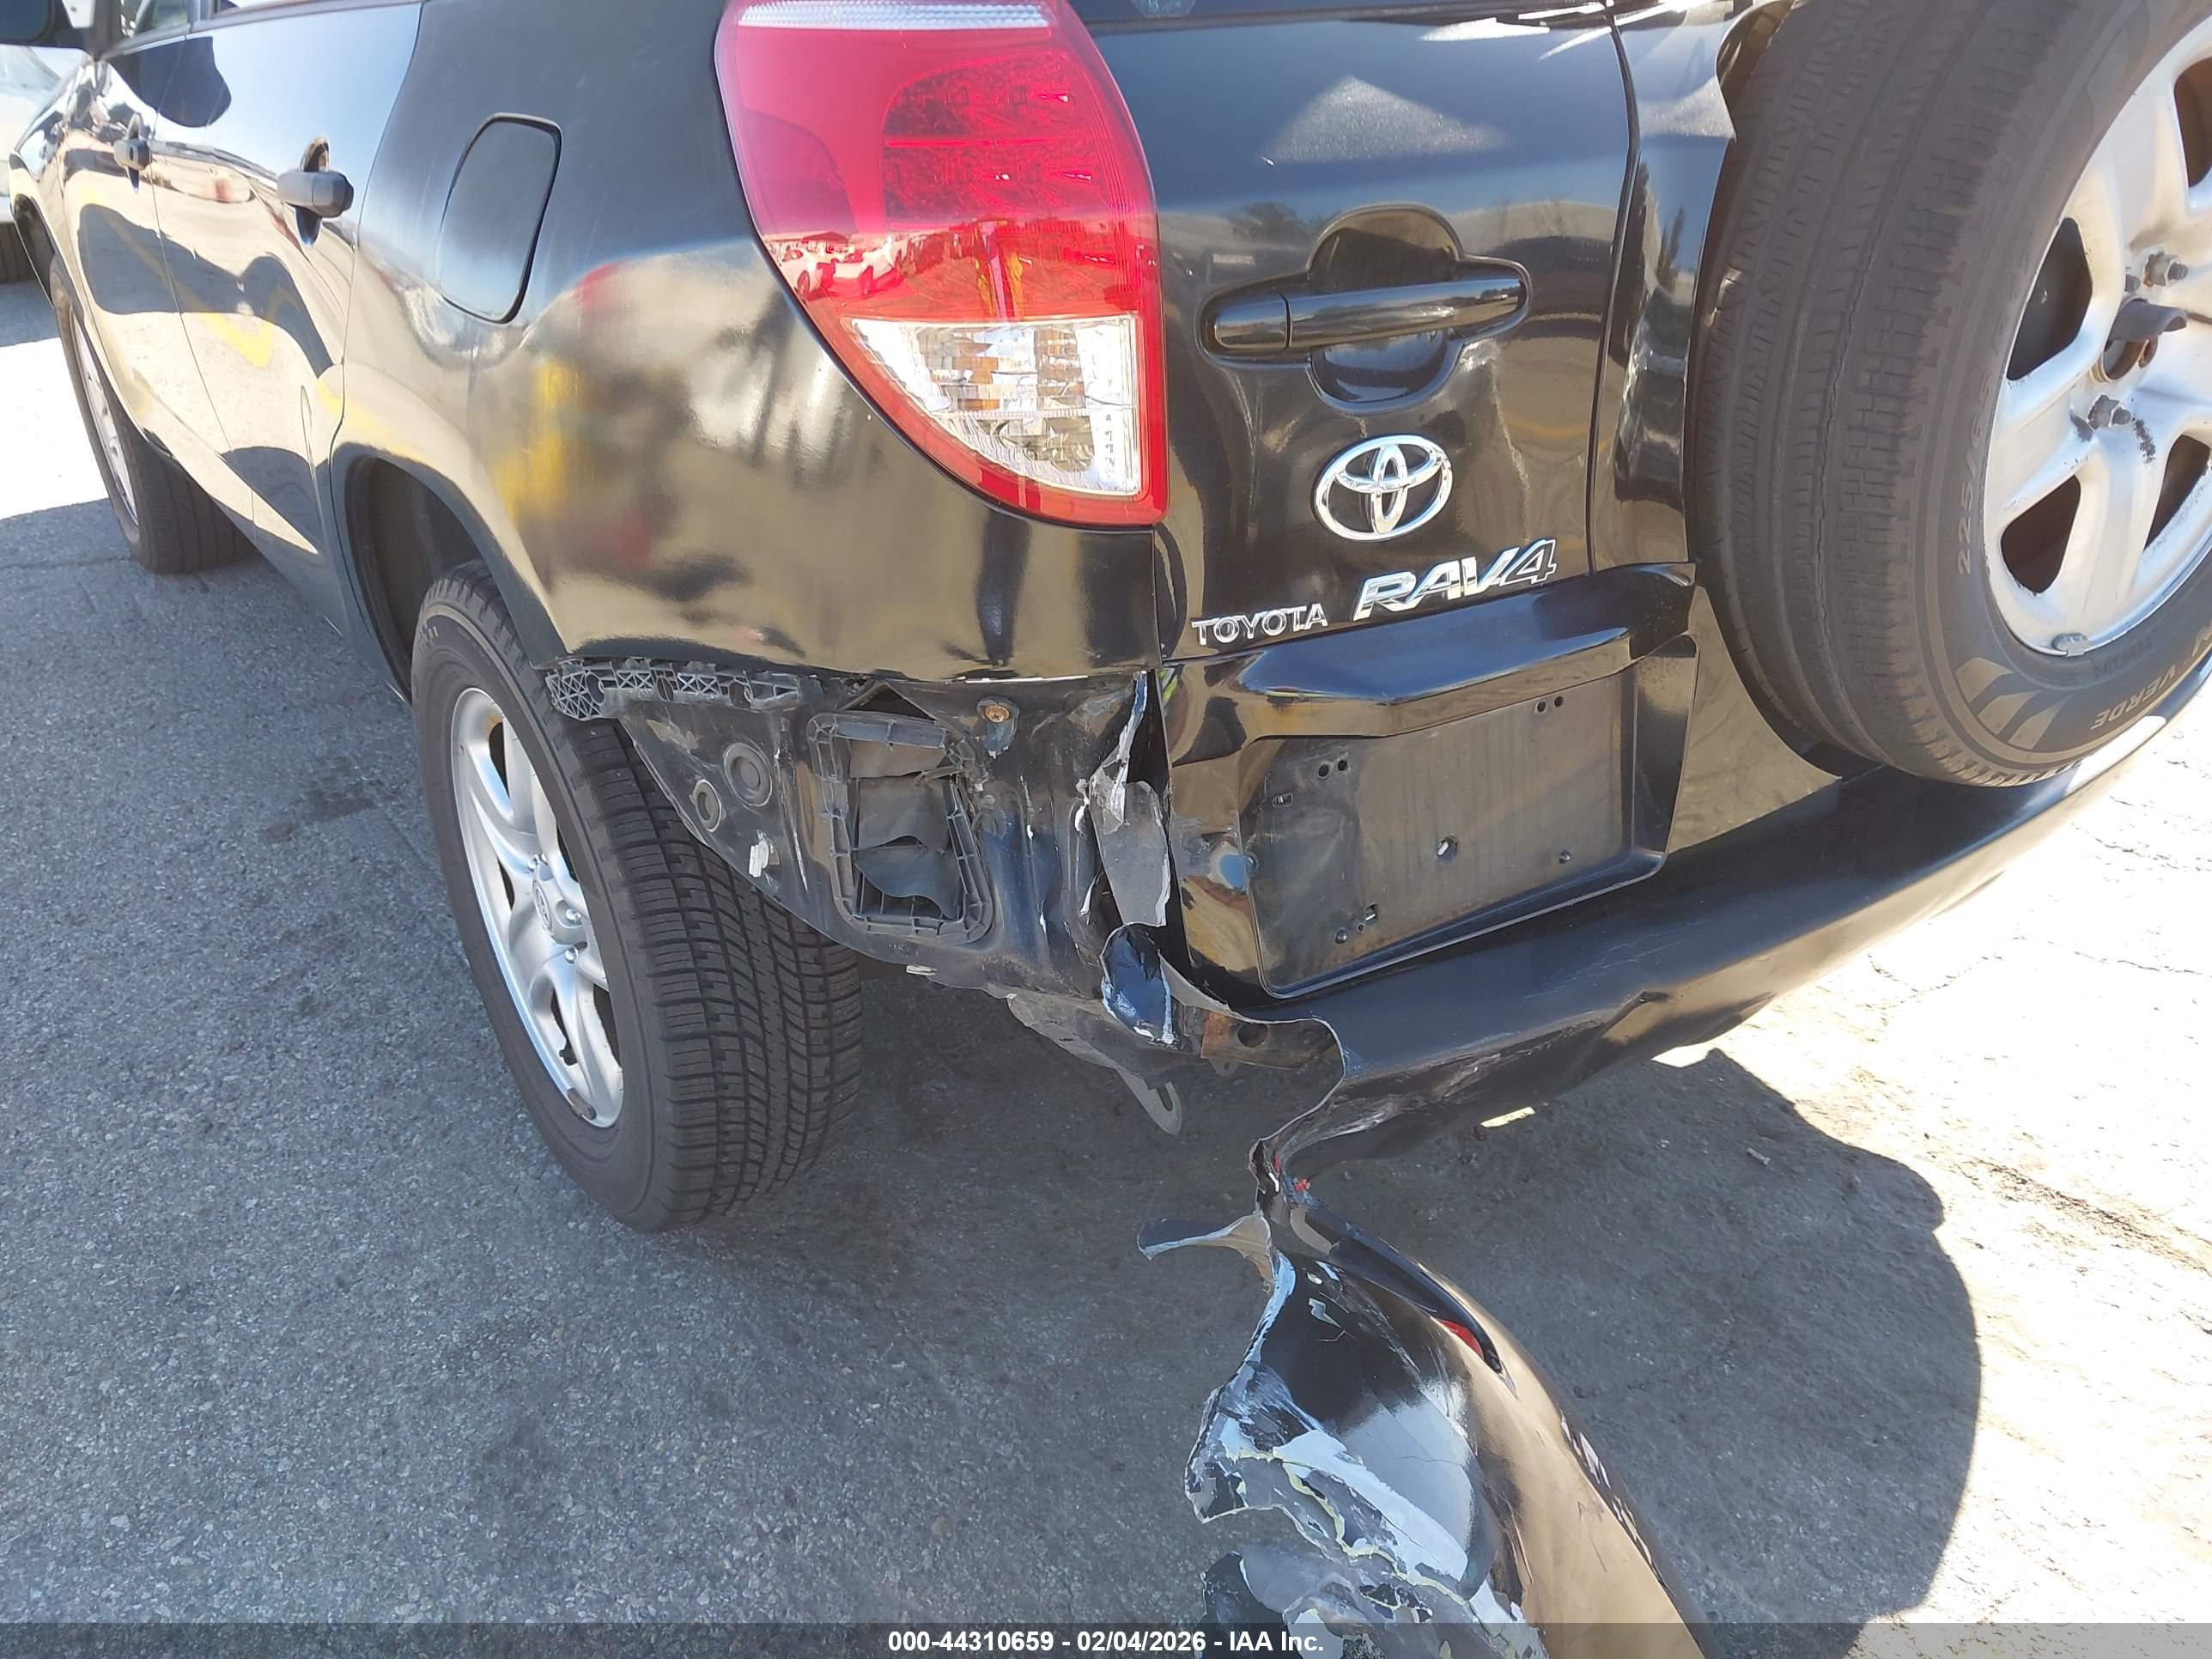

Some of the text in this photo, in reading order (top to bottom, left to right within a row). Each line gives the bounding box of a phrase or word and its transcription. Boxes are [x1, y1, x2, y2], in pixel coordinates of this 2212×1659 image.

[1191, 538, 1557, 645] TOYOTA RAV4
[2090, 665, 2177, 730] VERDE
